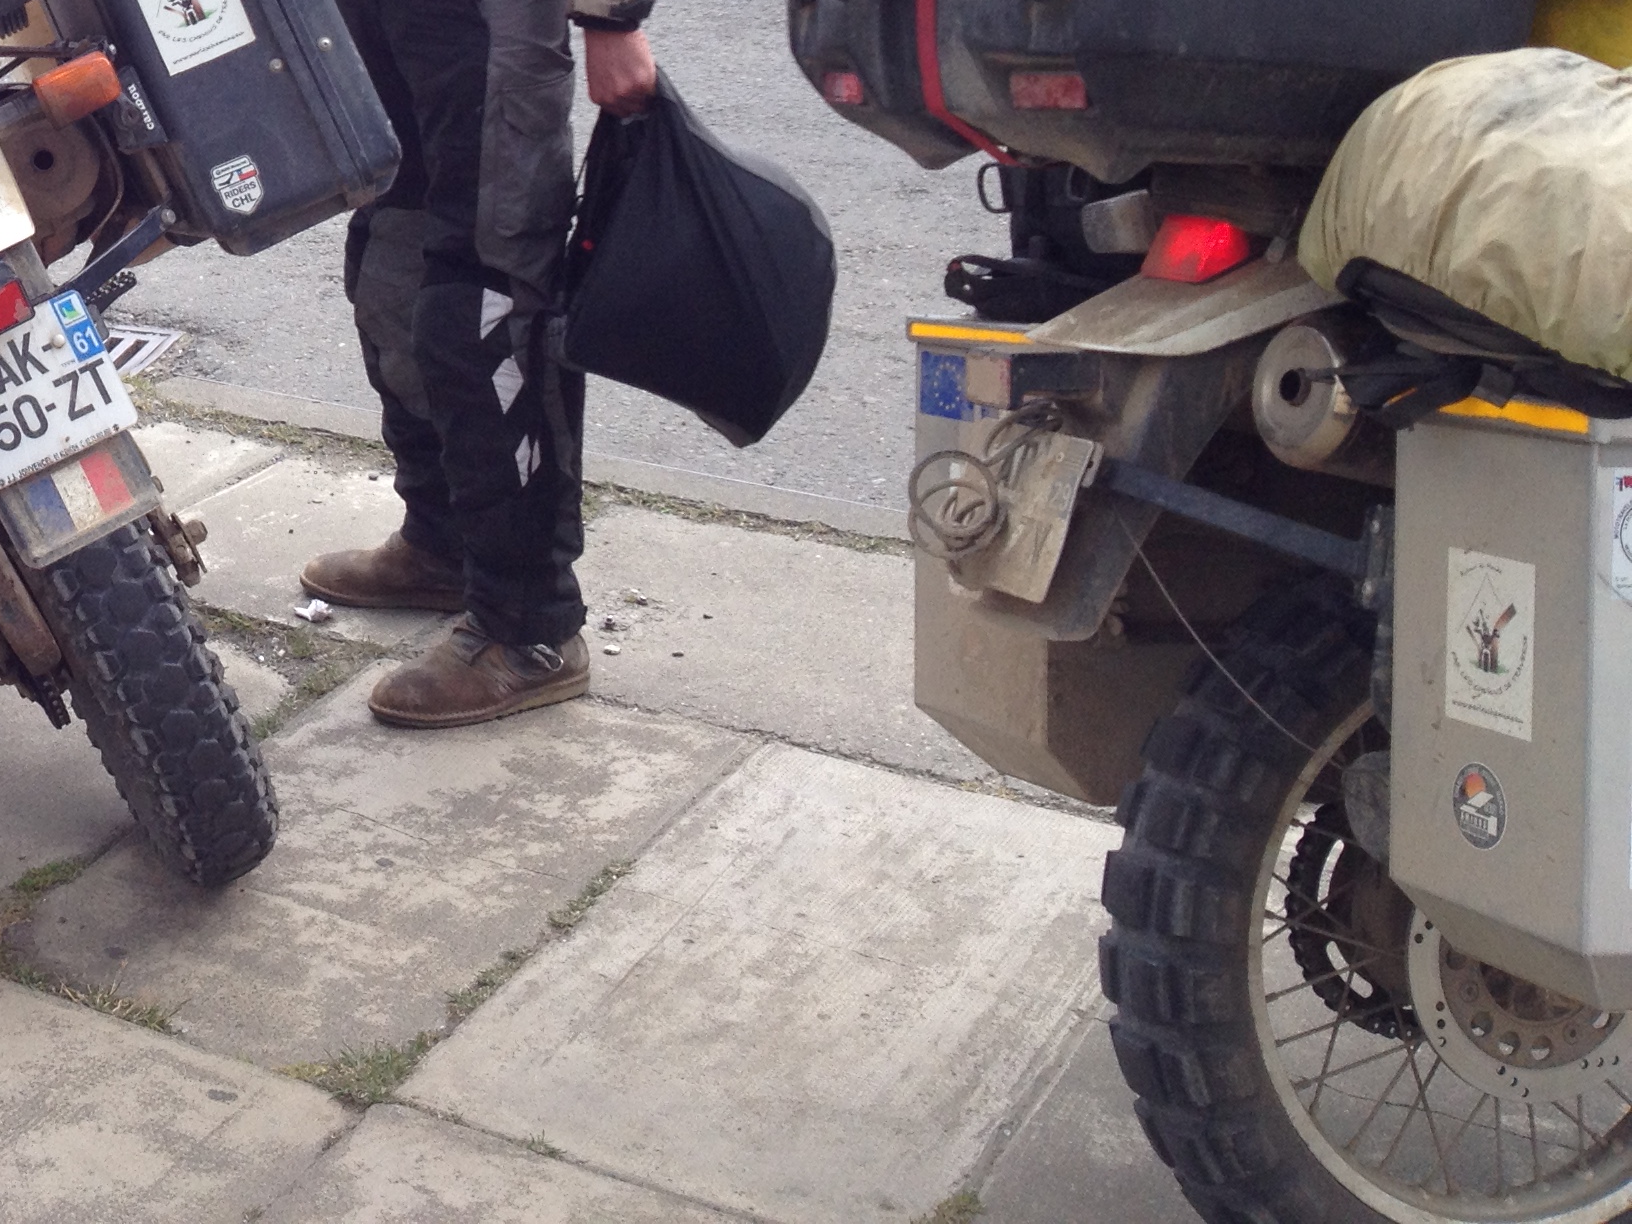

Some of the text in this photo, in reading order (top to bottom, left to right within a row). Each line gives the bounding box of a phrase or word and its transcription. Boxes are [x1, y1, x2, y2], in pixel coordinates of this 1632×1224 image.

[128, 83, 155, 131] caribou
[223, 180, 257, 200] RIDERS
[231, 192, 257, 209] CHL
[71, 328, 100, 354] 61
